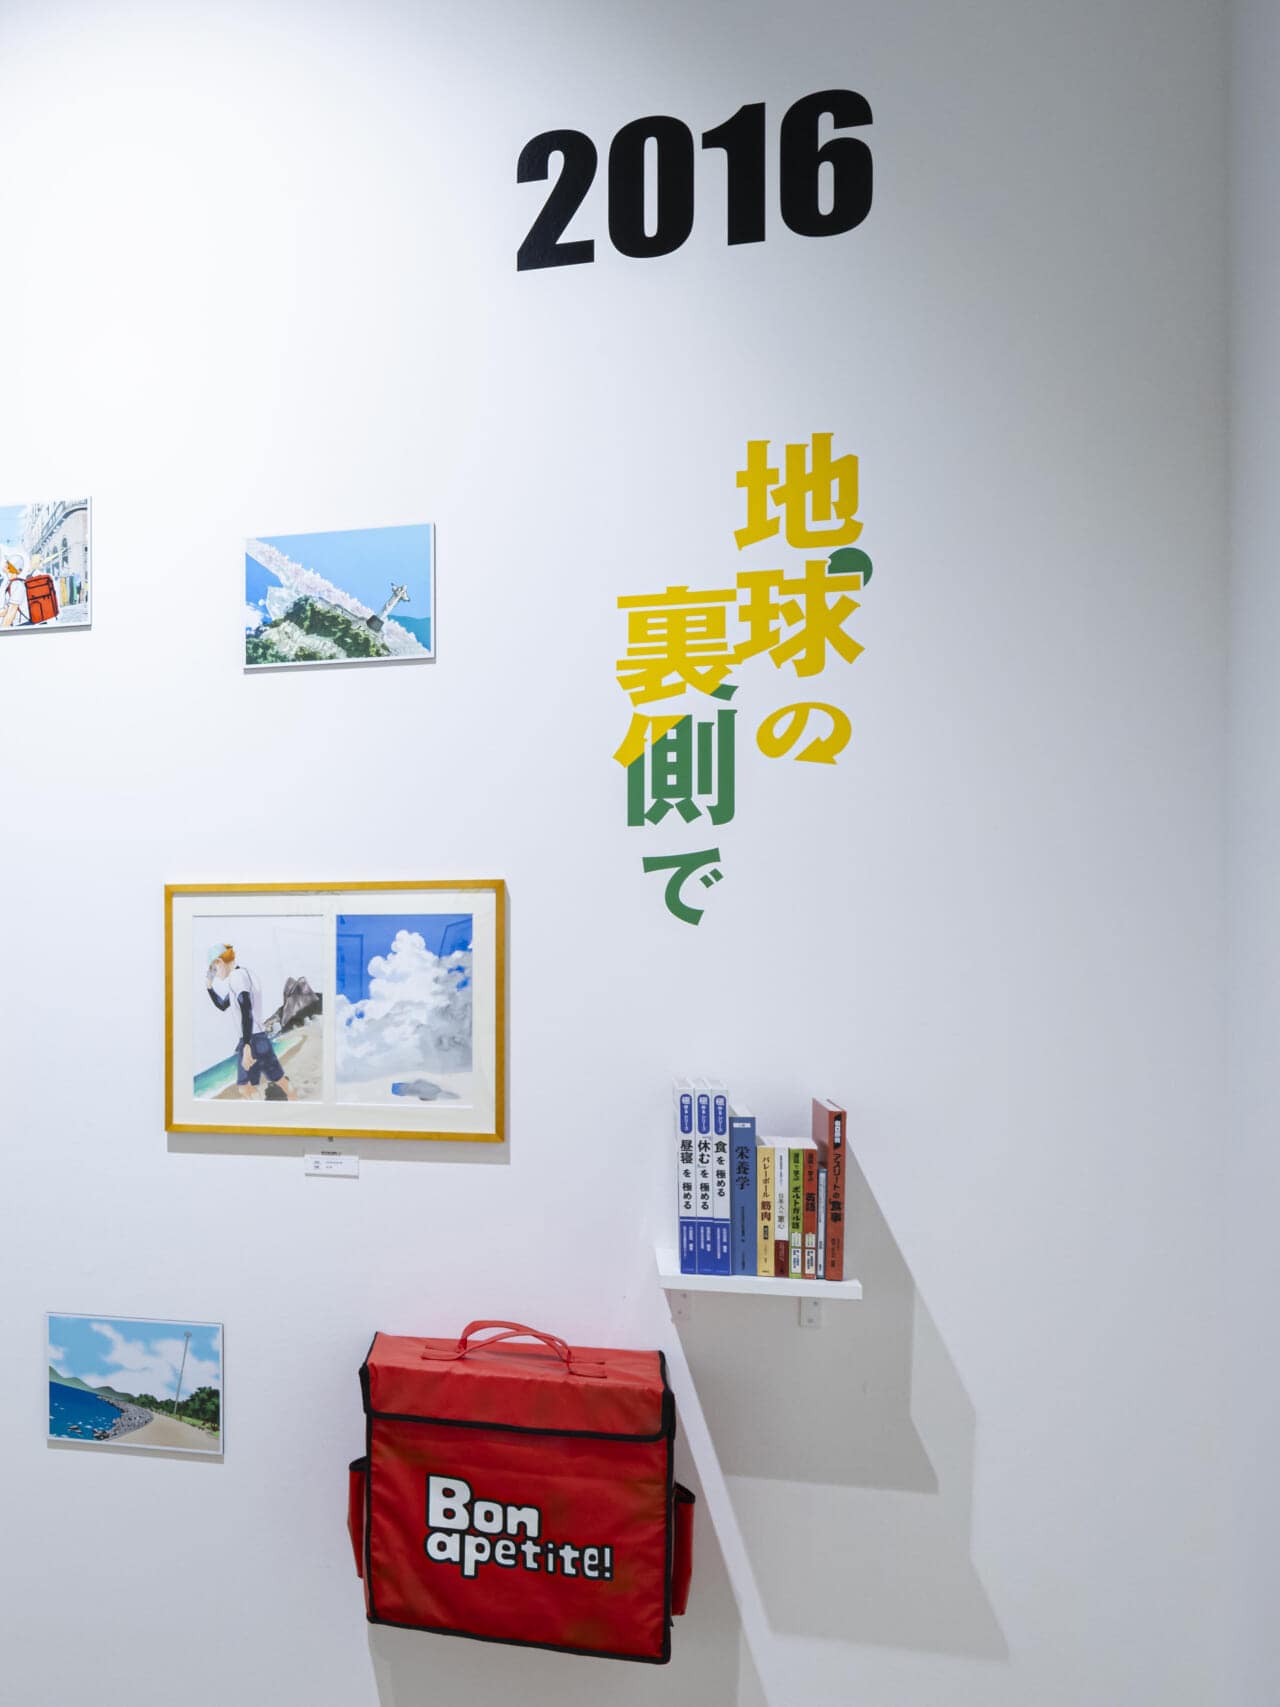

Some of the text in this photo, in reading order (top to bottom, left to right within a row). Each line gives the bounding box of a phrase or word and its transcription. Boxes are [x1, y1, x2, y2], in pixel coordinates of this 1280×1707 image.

[516, 88, 873, 271] 2016
[733, 432, 866, 765] 地球の
[613, 585, 744, 927] 裏側で
[735, 1145, 750, 1190] 栄養学
[425, 1532, 613, 1578] apetite!
[427, 1474, 540, 1538] Bon
